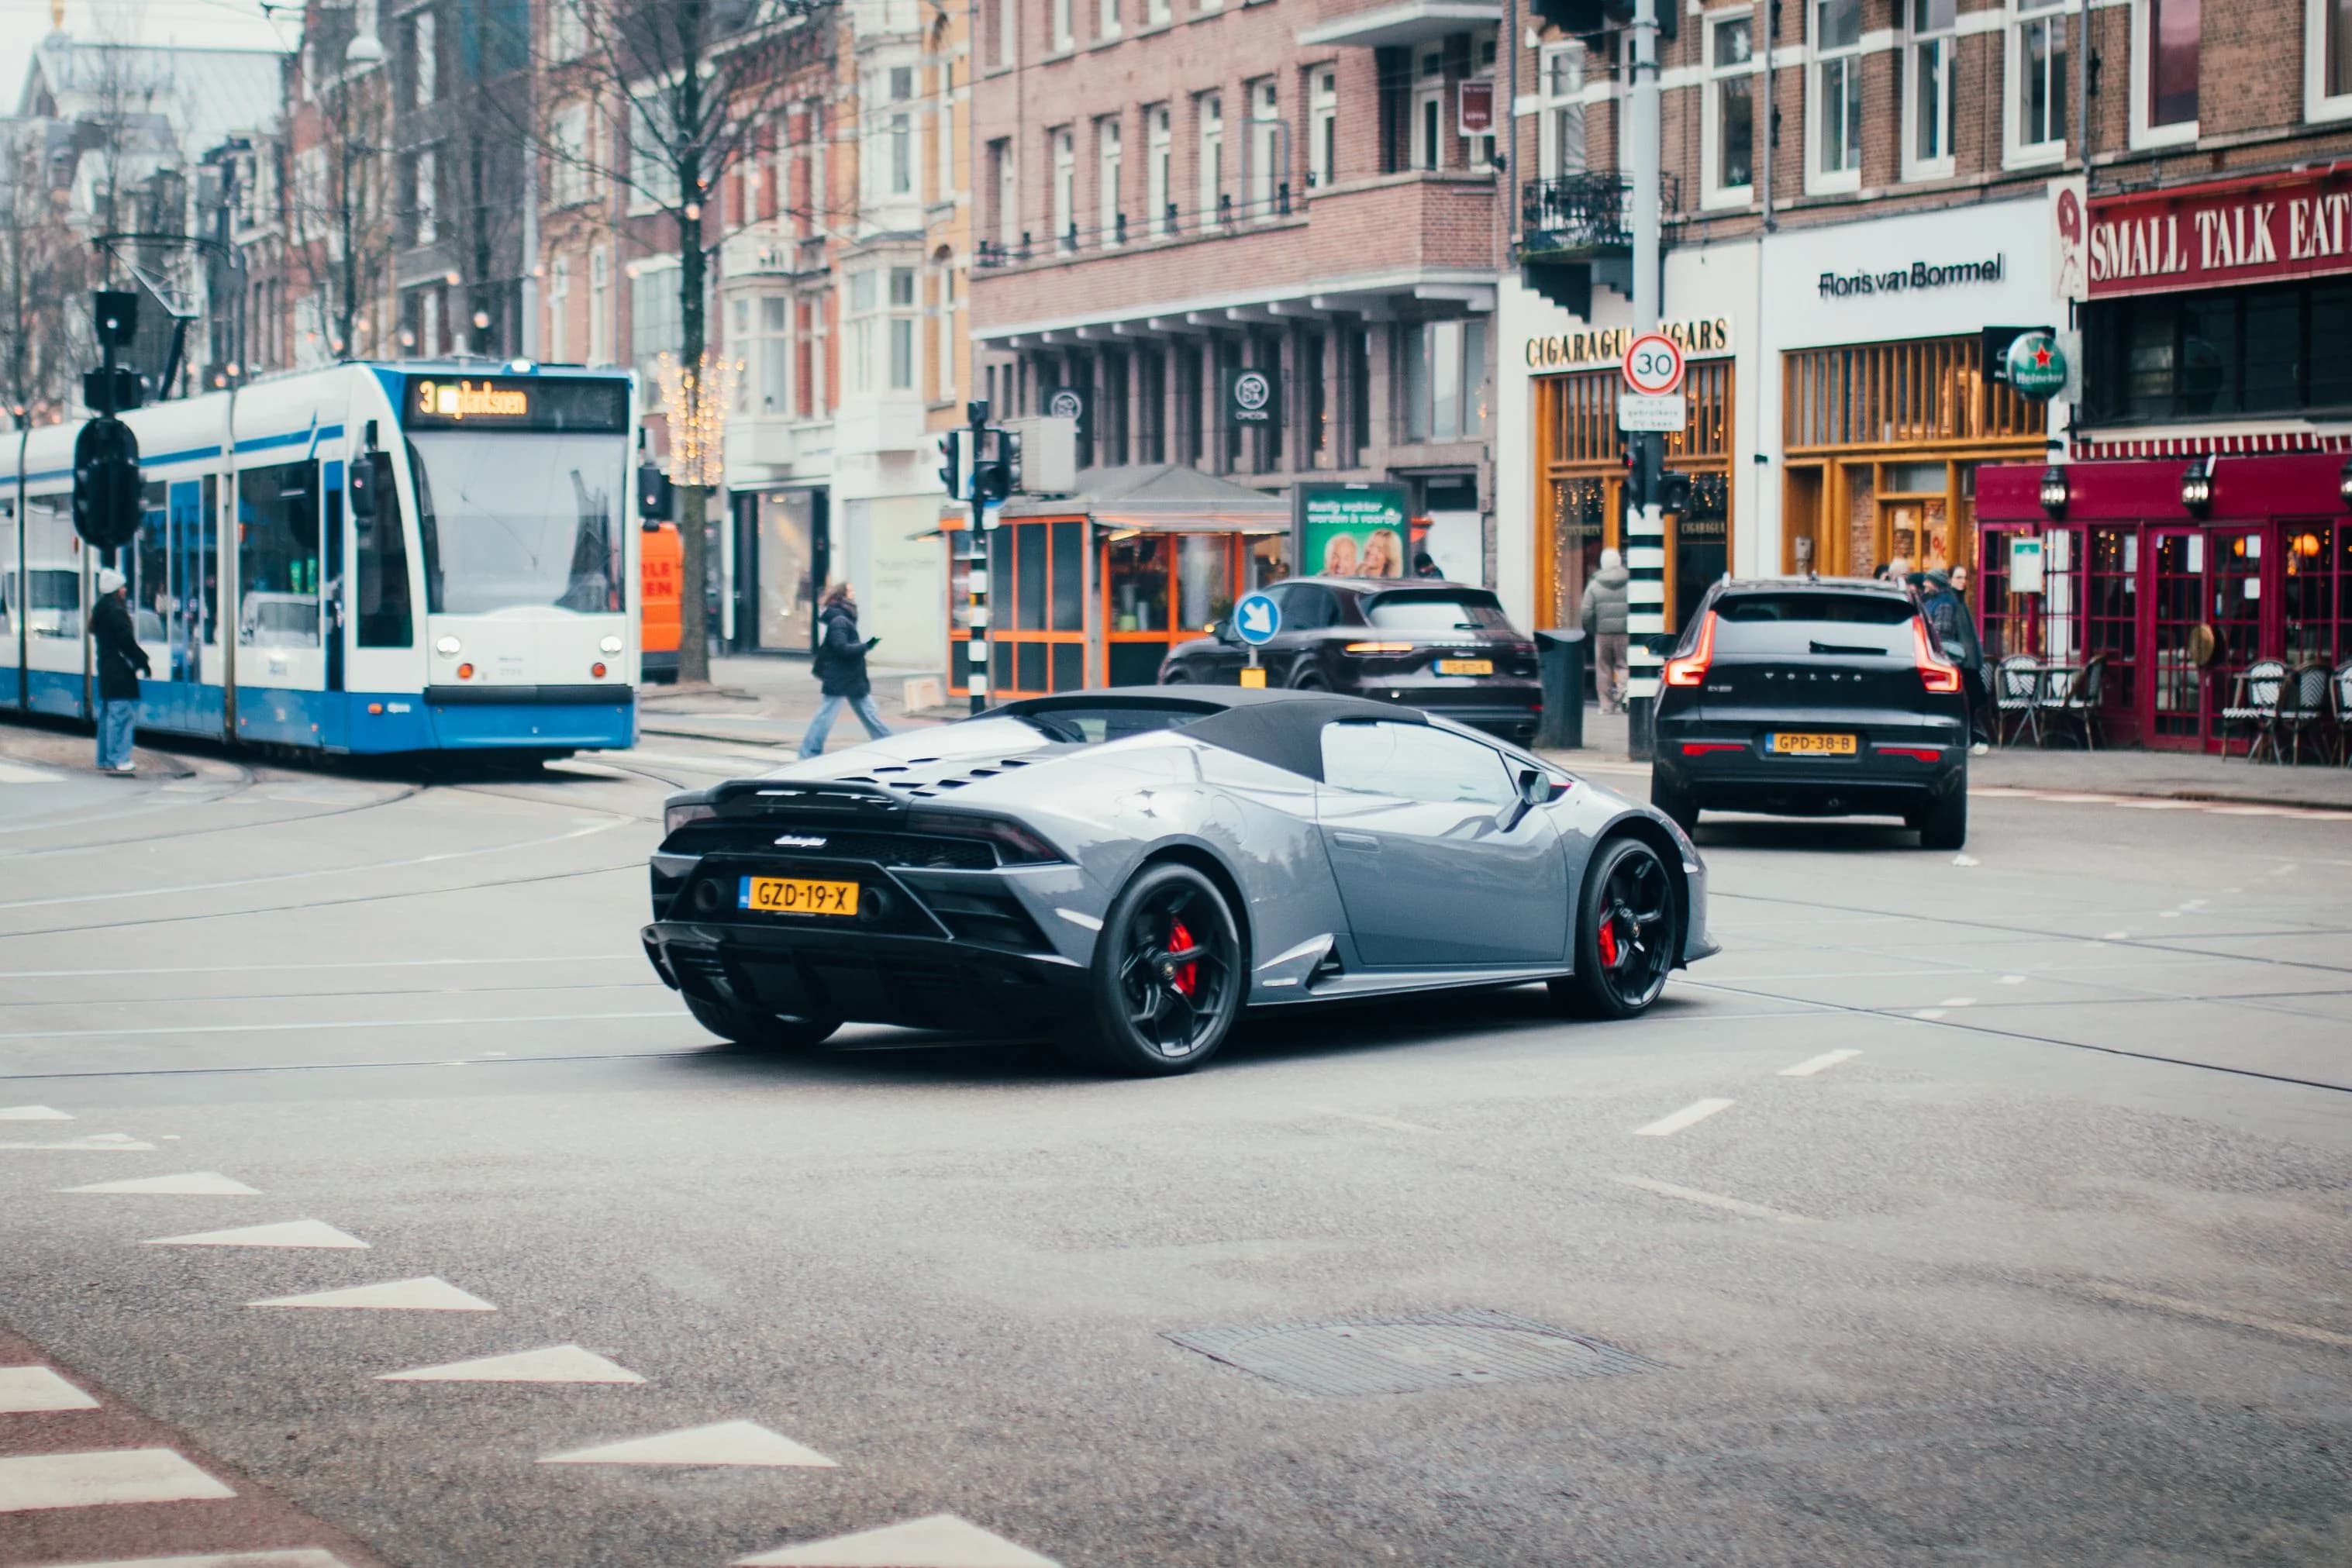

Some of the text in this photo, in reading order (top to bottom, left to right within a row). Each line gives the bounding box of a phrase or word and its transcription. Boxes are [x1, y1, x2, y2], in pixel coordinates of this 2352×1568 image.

[2091, 192, 2352, 281] SMALL TALK EAT
[1819, 252, 2002, 298] Floris van Bommel
[1526, 318, 1727, 367] CIGARAGU GARS
[1636, 353, 1672, 376] 30
[419, 381, 436, 414] 3
[1764, 672, 1862, 682] VOLVO
[758, 882, 849, 912] GZD-19-X
